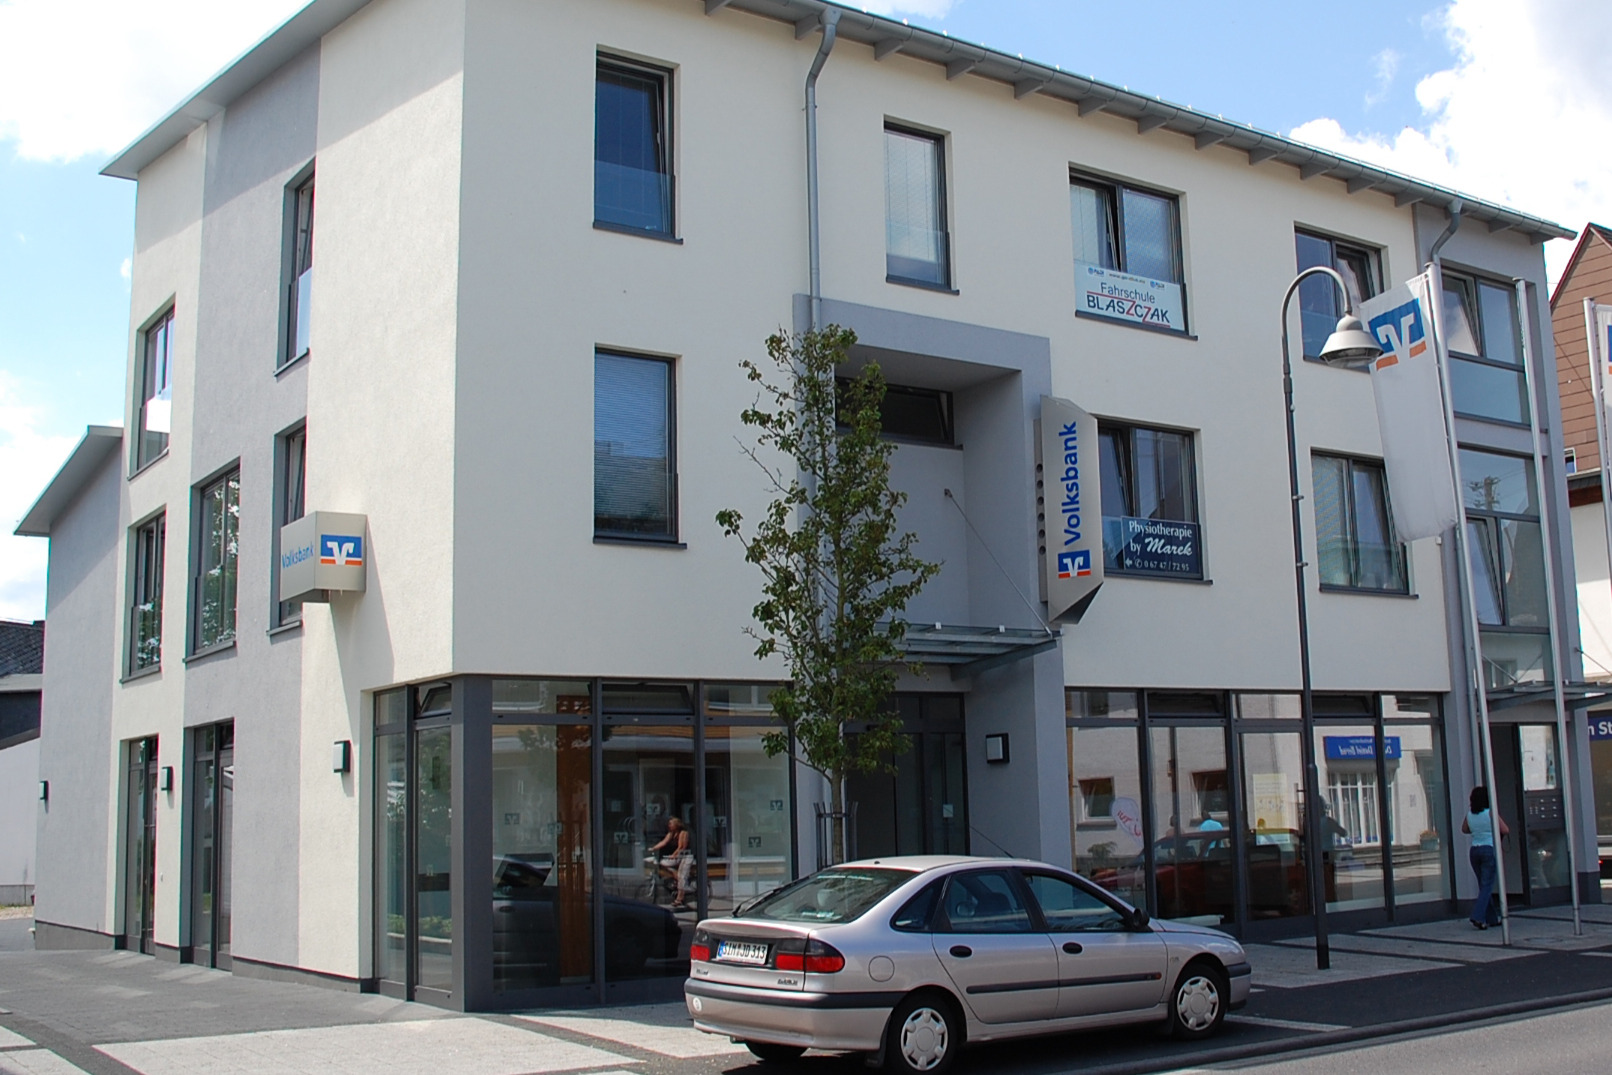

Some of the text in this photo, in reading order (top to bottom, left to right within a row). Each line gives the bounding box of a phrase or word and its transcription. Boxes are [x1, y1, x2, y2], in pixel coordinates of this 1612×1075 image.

[1101, 282, 1155, 304] Fahrschule
[1087, 294, 1170, 325] BLASZCZAK
[1058, 421, 1081, 546] Volksbank
[1128, 520, 1192, 540] Physiotherapie
[282, 541, 314, 568] Volksbank
[1130, 537, 1192, 556] by Marek
[751, 944, 766, 959] 313
